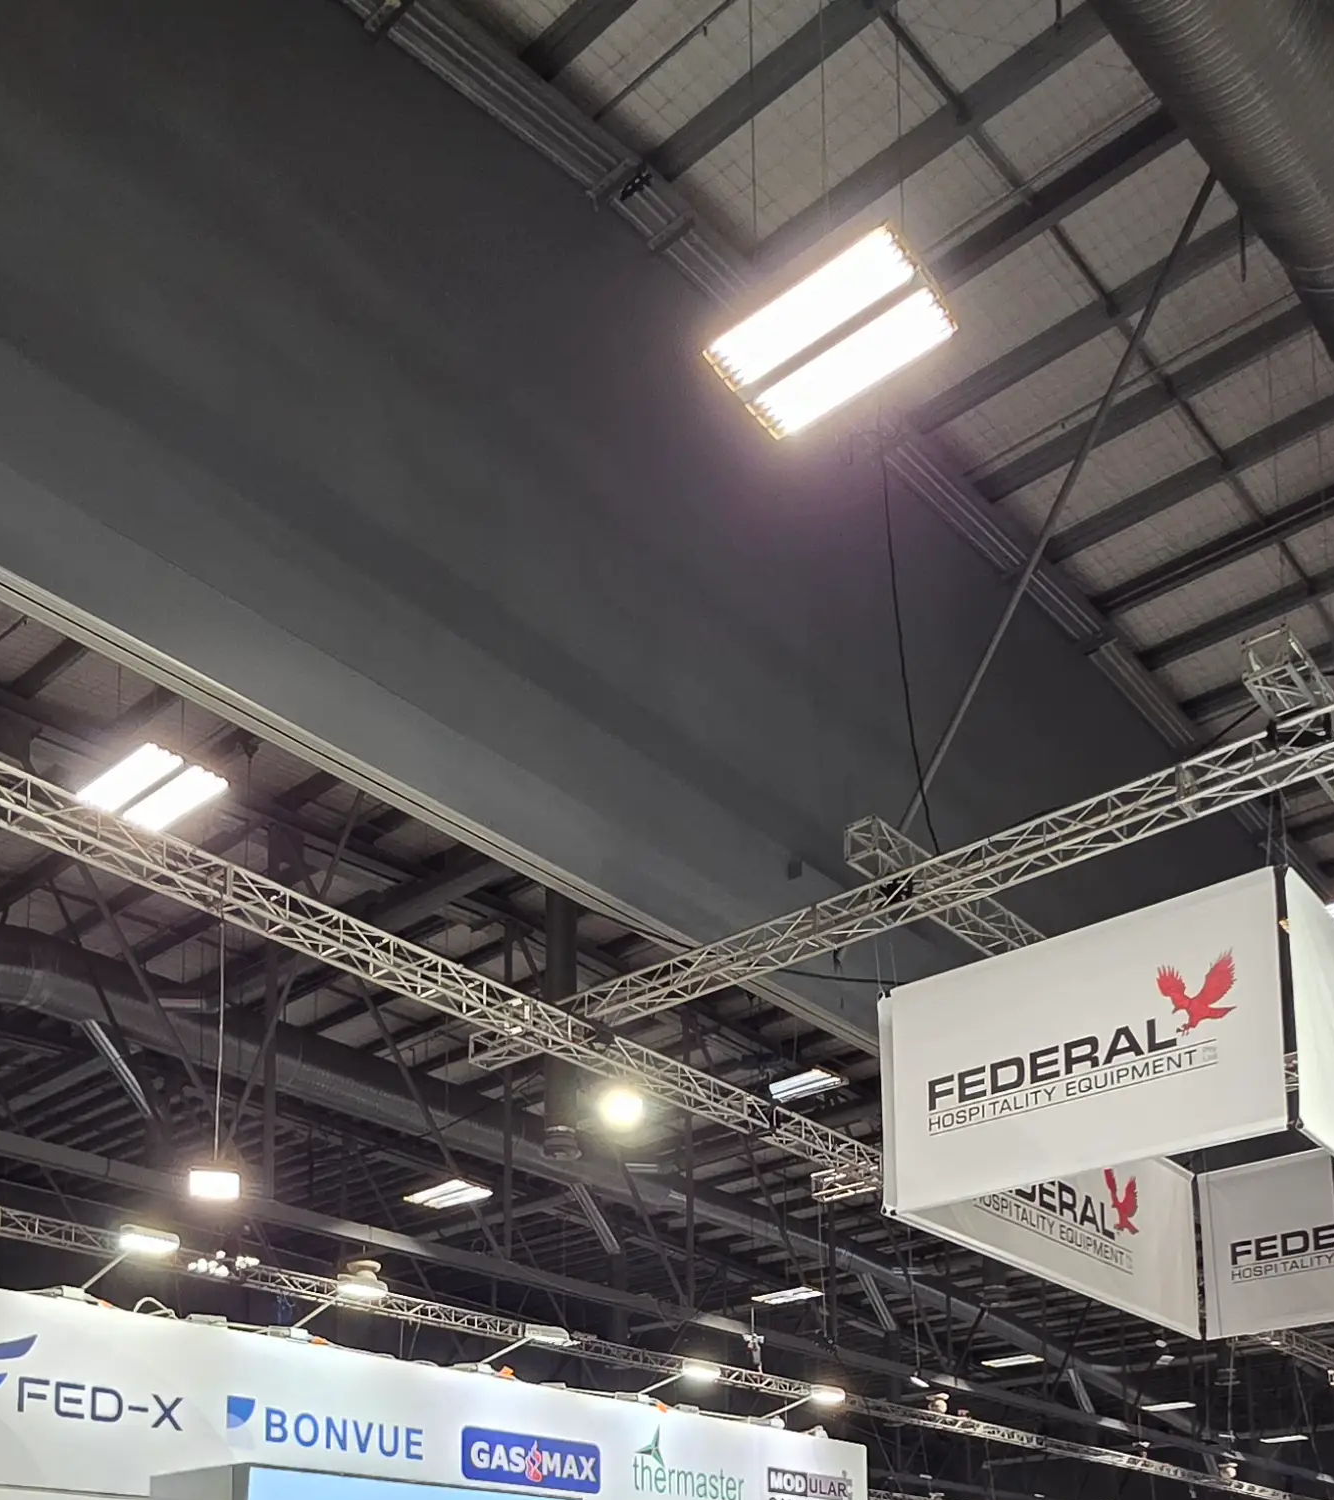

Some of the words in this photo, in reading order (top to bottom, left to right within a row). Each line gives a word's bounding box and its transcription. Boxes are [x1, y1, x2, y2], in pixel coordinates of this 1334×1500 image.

[928, 1018, 1178, 1112] FEDERAL
[928, 1086, 1057, 1133] HOSPITALITY
[1064, 1049, 1198, 1097] EQUIPMENT
[1059, 1224, 1124, 1263] EQUIPMENT
[1232, 1252, 1334, 1282] HOSPITALITY
[17, 1376, 184, 1432] FED-X
[264, 1407, 424, 1461] BONVUE
[769, 1469, 848, 1499] MODULAR
